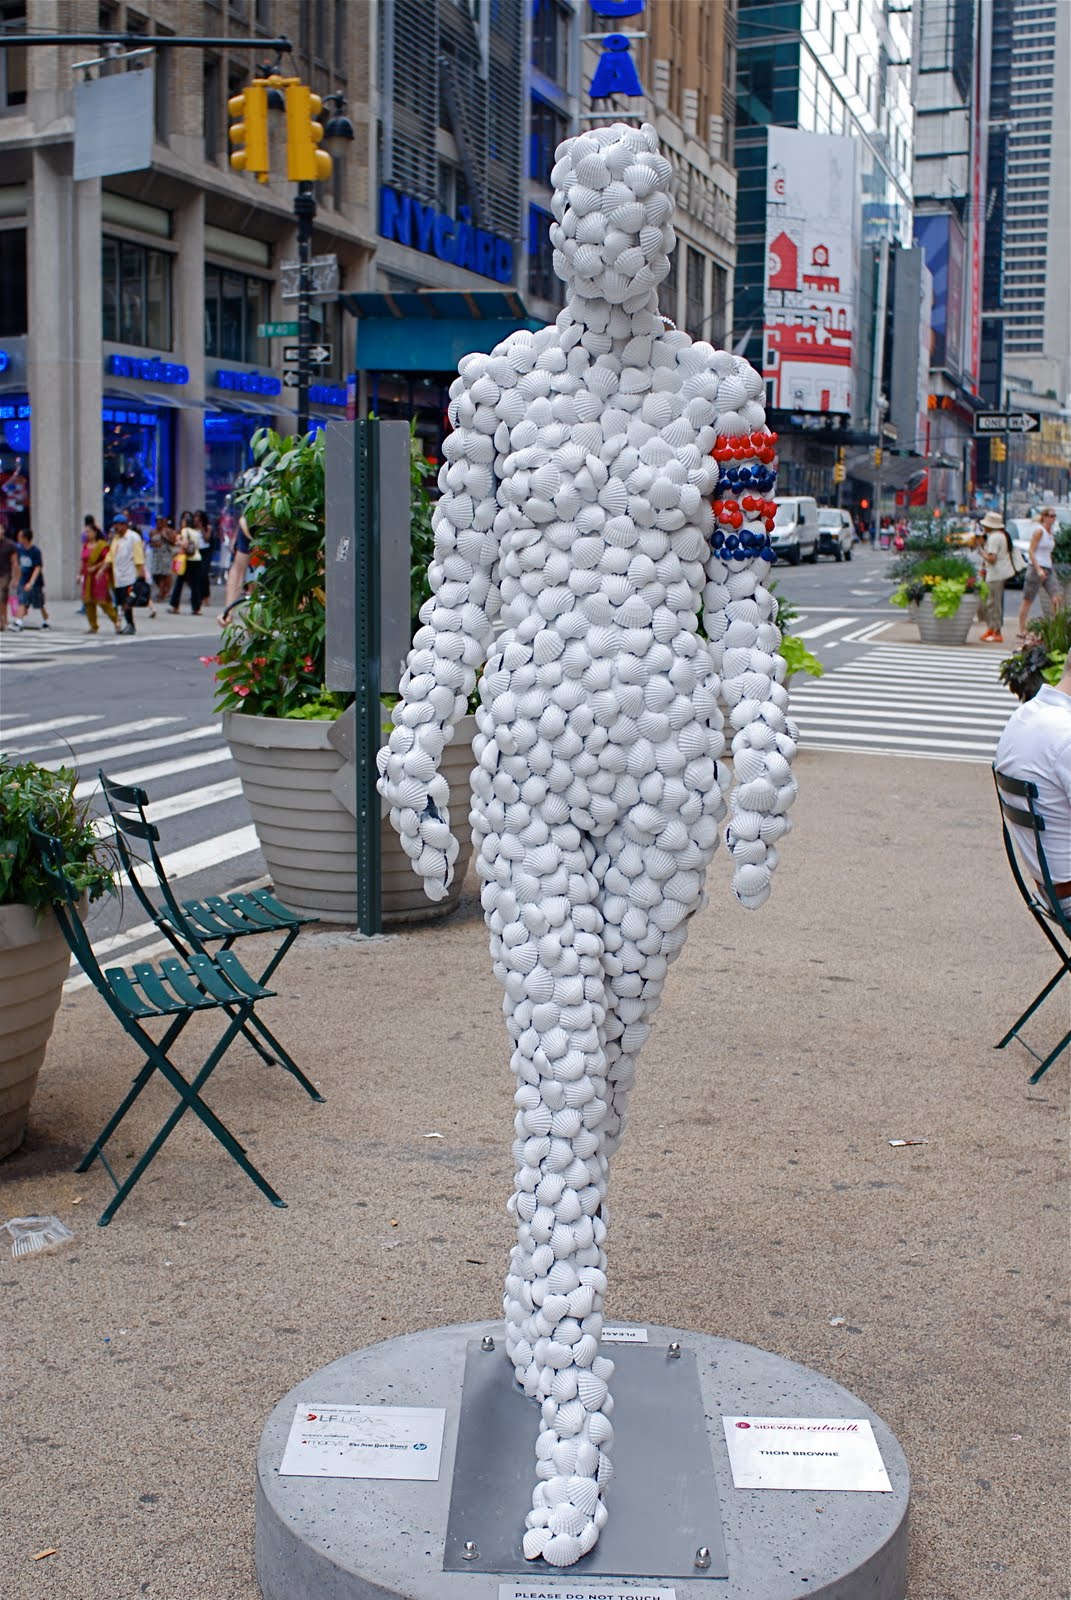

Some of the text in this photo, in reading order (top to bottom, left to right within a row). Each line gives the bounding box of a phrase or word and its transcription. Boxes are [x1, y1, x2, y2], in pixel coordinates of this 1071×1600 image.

[319, 1414, 374, 1424] LF USA
[515, 1592, 562, 1600] PLEASE
